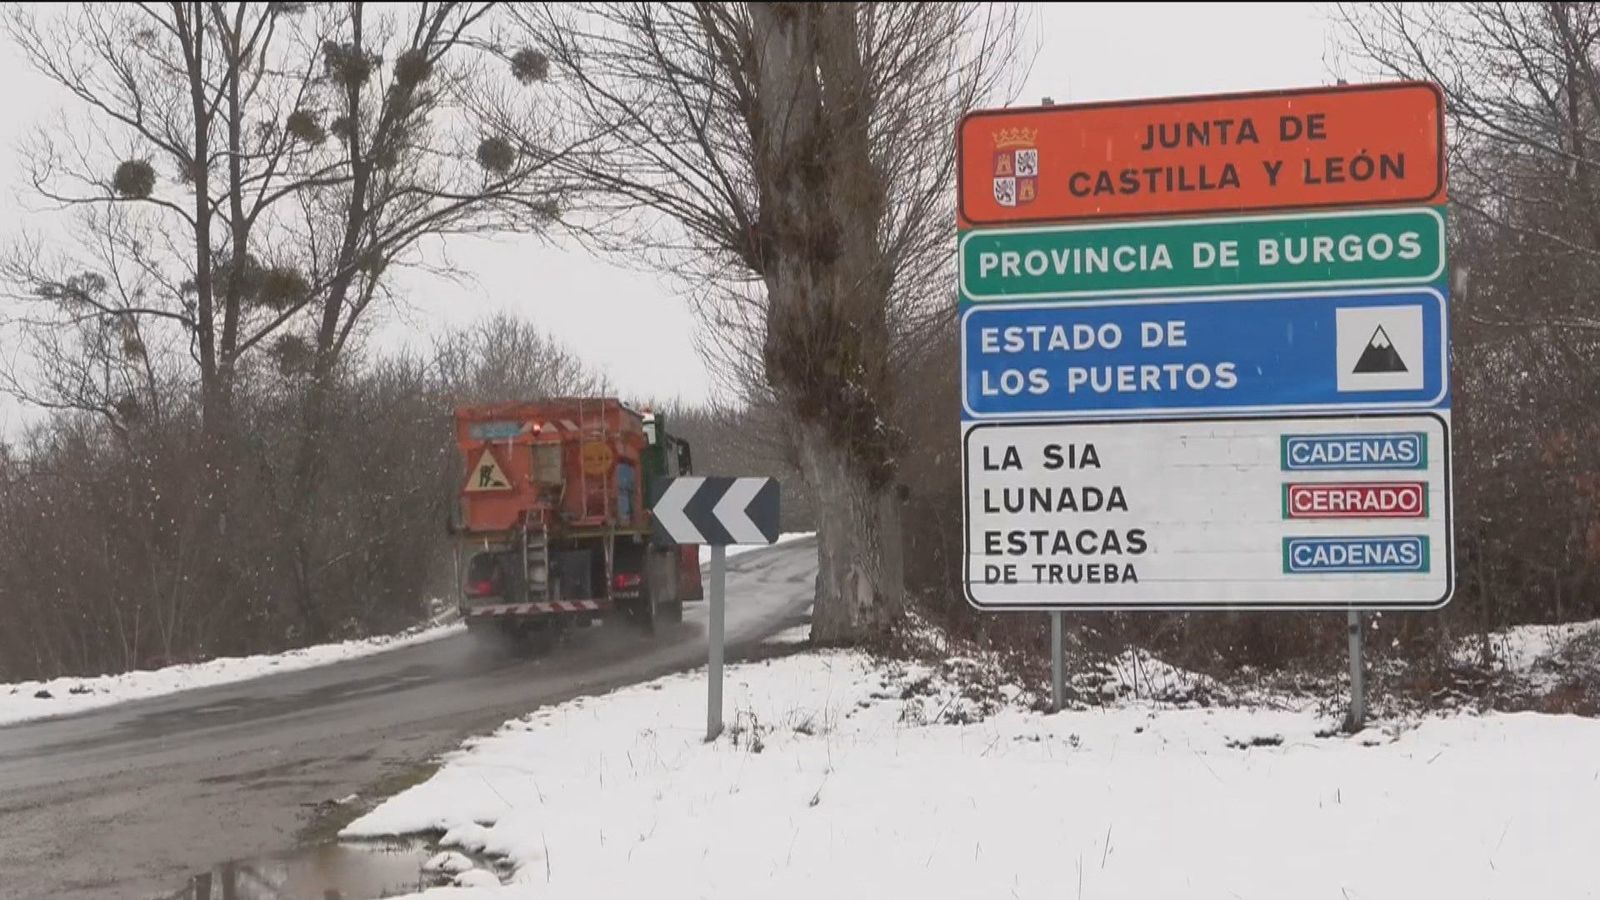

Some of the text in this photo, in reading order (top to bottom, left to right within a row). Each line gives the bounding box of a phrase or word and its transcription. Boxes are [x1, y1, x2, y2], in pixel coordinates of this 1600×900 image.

[1141, 113, 1327, 151] JUNTA DE
[1068, 149, 1405, 197] CASTILLA Y LEÓN
[979, 231, 1422, 278] PROVINCIA DE BURGOS
[981, 321, 1187, 353] ESTADO DE
[981, 362, 1238, 396] LOS PUERTOS
[983, 443, 1102, 471] LA SIA
[1292, 439, 1414, 463] CADENAS
[984, 486, 1129, 513] LUNADA
[1294, 489, 1418, 512] CERRADO
[984, 529, 1149, 556] ESTACAS
[1294, 543, 1417, 566] CADENAS
[984, 563, 1138, 584] DE TRUEBA
